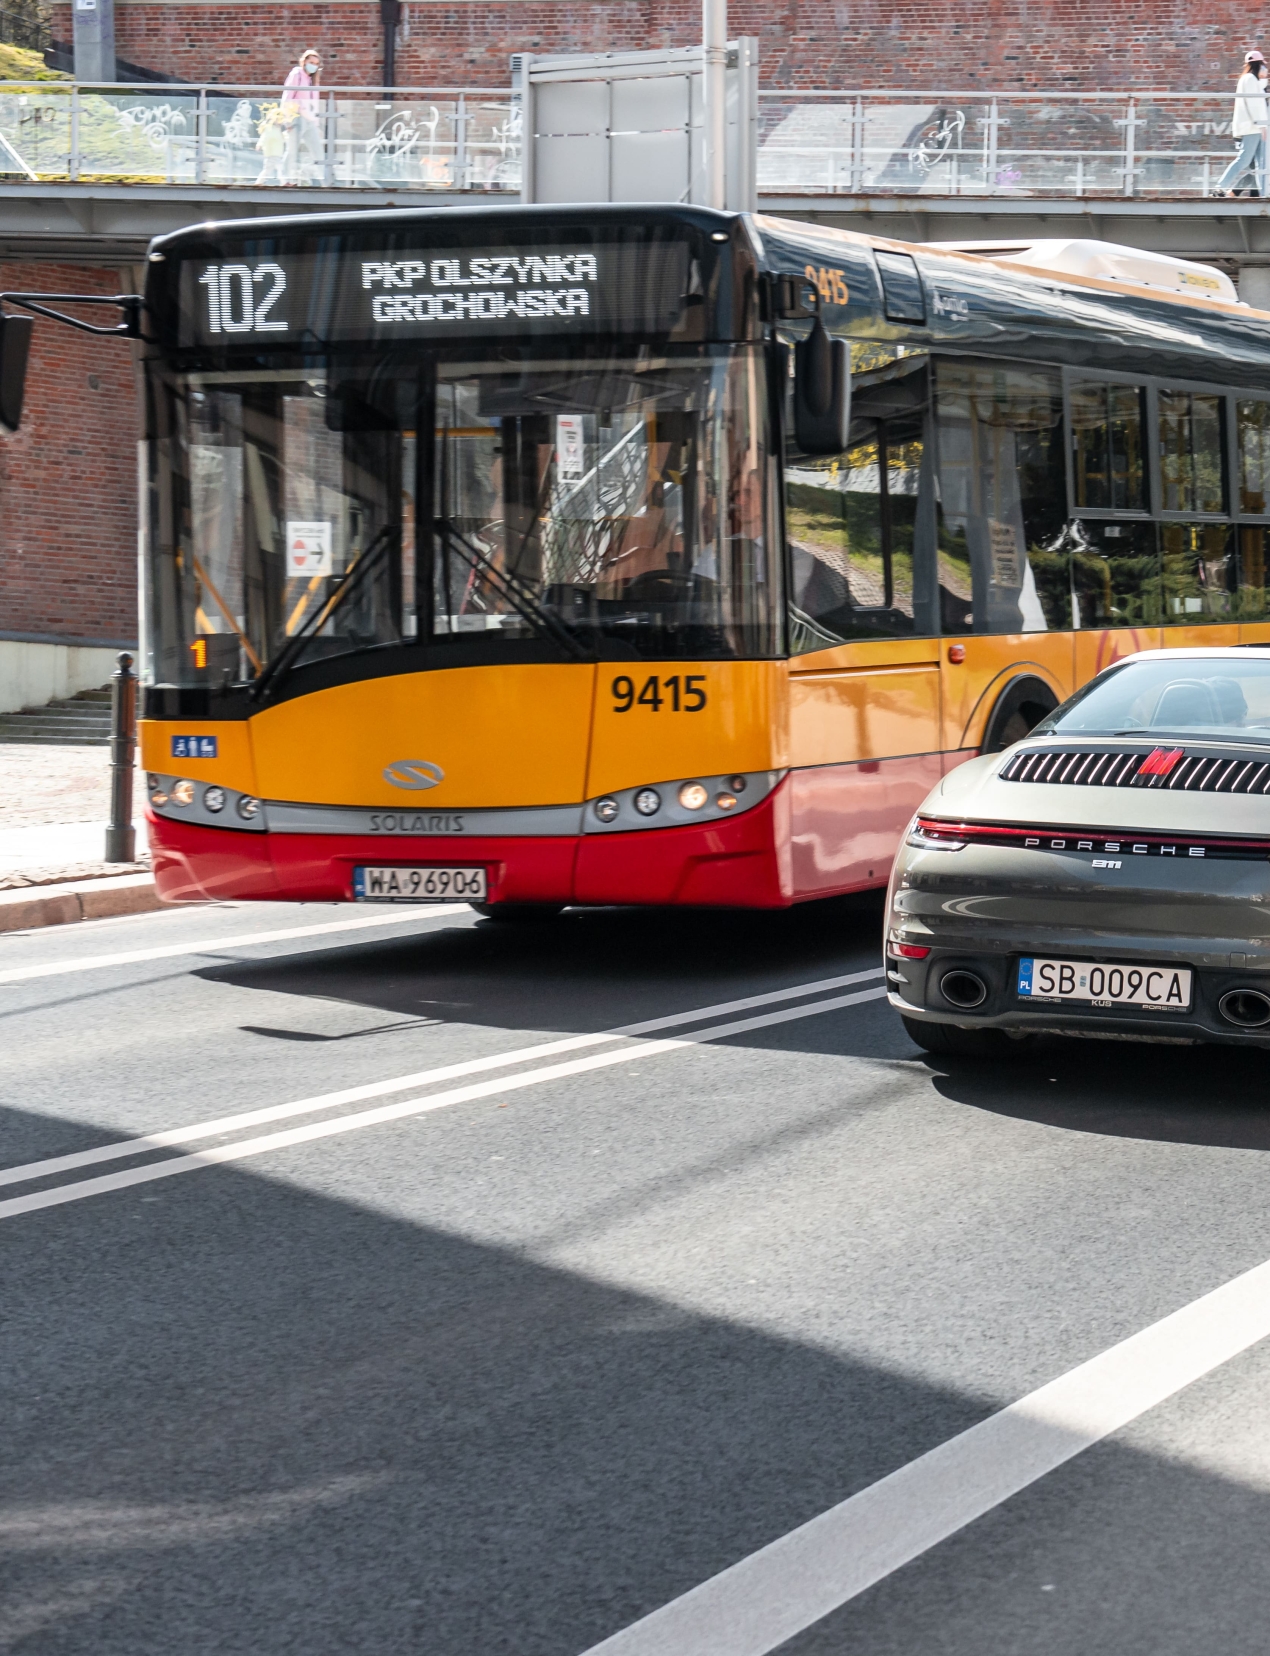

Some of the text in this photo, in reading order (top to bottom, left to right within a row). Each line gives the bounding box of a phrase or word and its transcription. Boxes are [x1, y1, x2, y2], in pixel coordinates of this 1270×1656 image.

[361, 254, 597, 289] PKP OLSZYNKA
[199, 263, 288, 333] 102
[371, 288, 590, 323] GROCHOWSKA
[190, 640, 206, 667] 1
[611, 675, 707, 713] 9415
[369, 814, 465, 832] SOLARIS
[1025, 838, 1206, 857] PORSCHE
[1092, 859, 1122, 869] 911
[368, 870, 481, 894] WA 96906
[1020, 980, 1031, 990] PL
[1039, 963, 1183, 1003] SB 009CA
[1018, 995, 1062, 1003] PORSCHE
[1091, 999, 1112, 1007] KUS
[1142, 1004, 1187, 1012] PORSCHE
